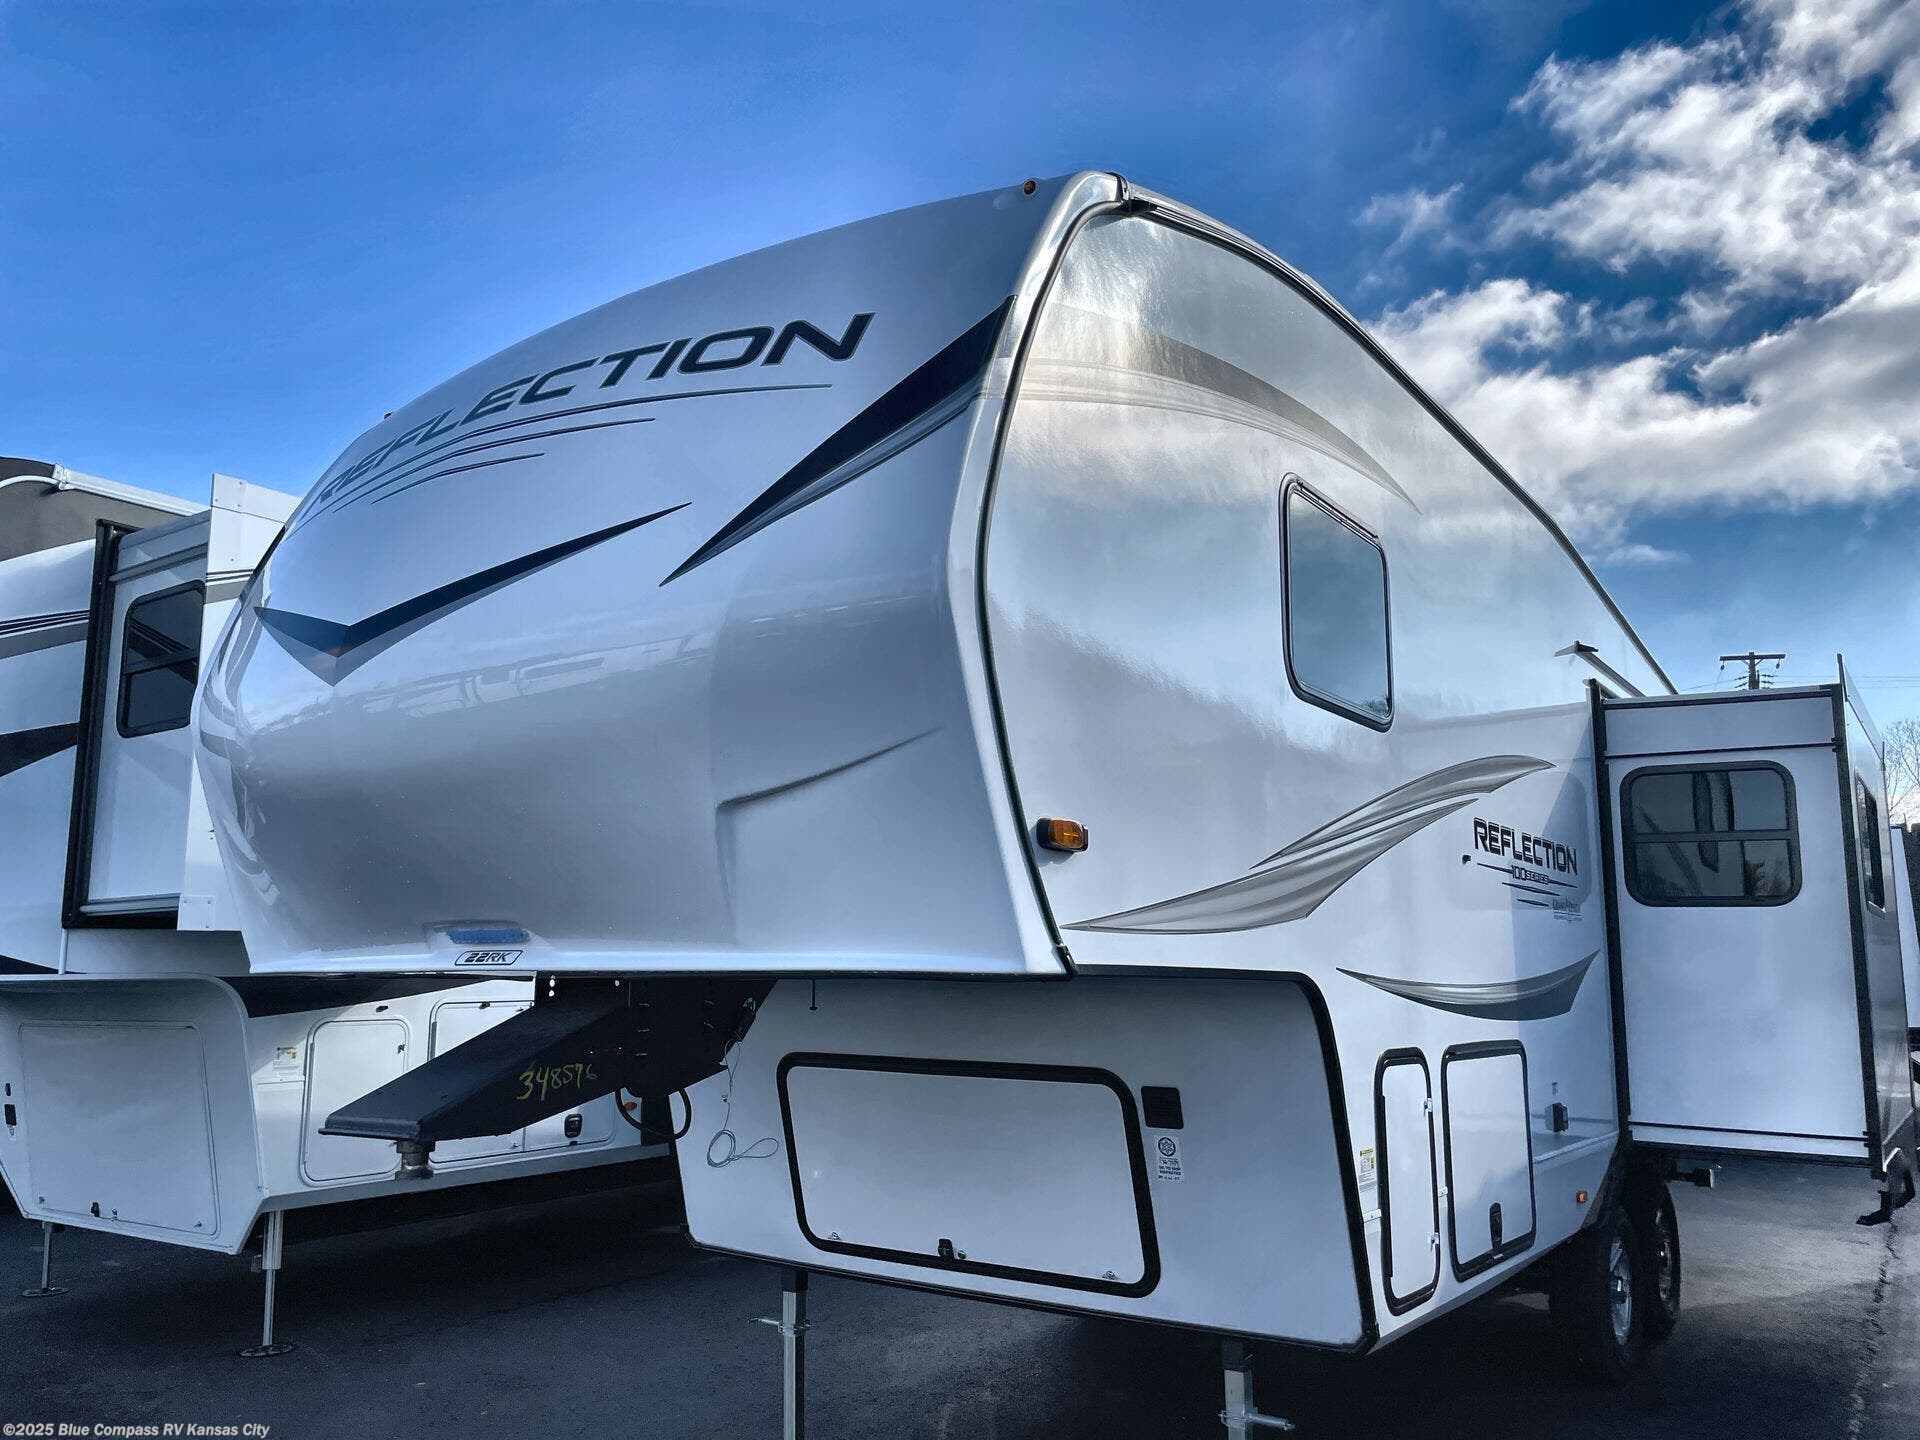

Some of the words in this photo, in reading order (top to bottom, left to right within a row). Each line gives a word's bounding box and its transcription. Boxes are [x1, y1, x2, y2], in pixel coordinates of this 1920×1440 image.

[302, 312, 876, 520] REFLECTION
[1473, 817, 1578, 876] REFLECTION
[464, 952, 513, 963] 22RK
[516, 1062, 598, 1101] 348576
